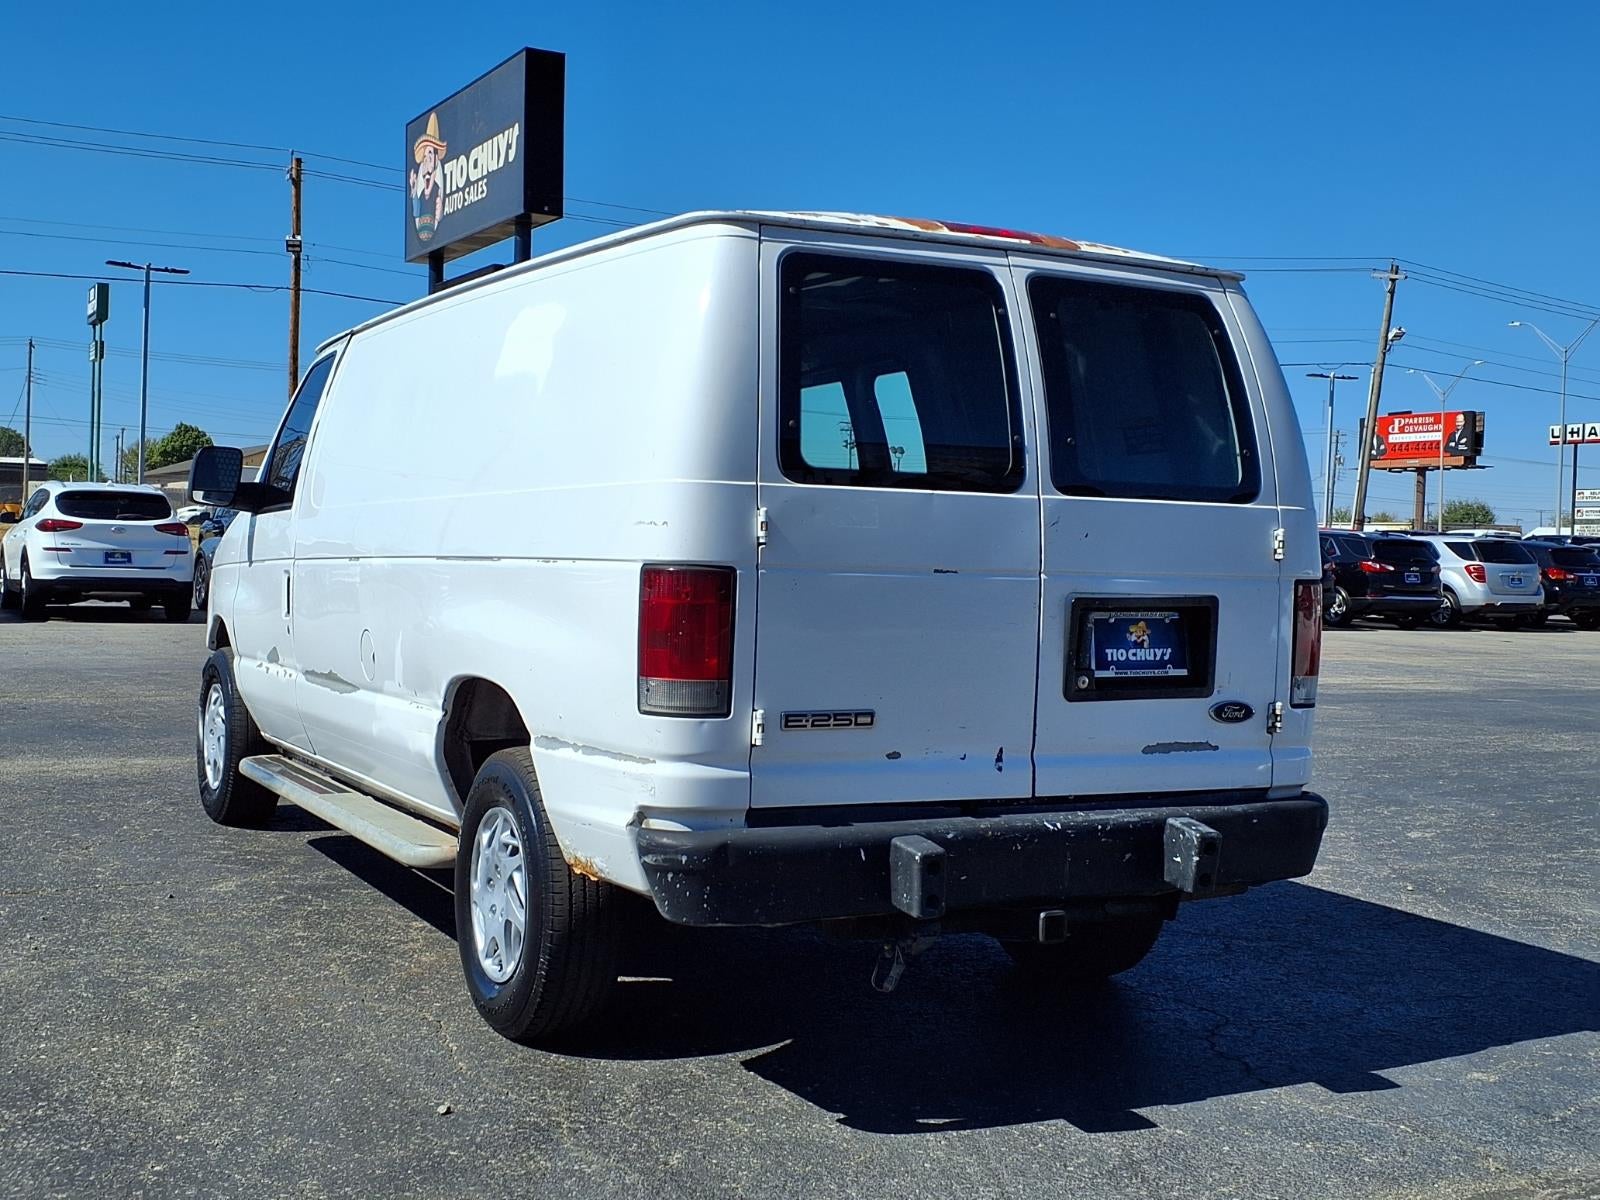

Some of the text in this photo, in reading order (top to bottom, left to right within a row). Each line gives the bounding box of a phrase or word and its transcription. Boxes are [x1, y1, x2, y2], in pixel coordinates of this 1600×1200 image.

[444, 123, 519, 194] TIO CHUY'S
[444, 178, 487, 215] AUTO SALES
[1404, 416, 1434, 424] PARRISH
[1404, 424, 1442, 432] DEVAUGHN
[1105, 648, 1172, 661] TIO CHUY'S
[1222, 705, 1246, 718] Ford
[784, 711, 875, 729] E-250
